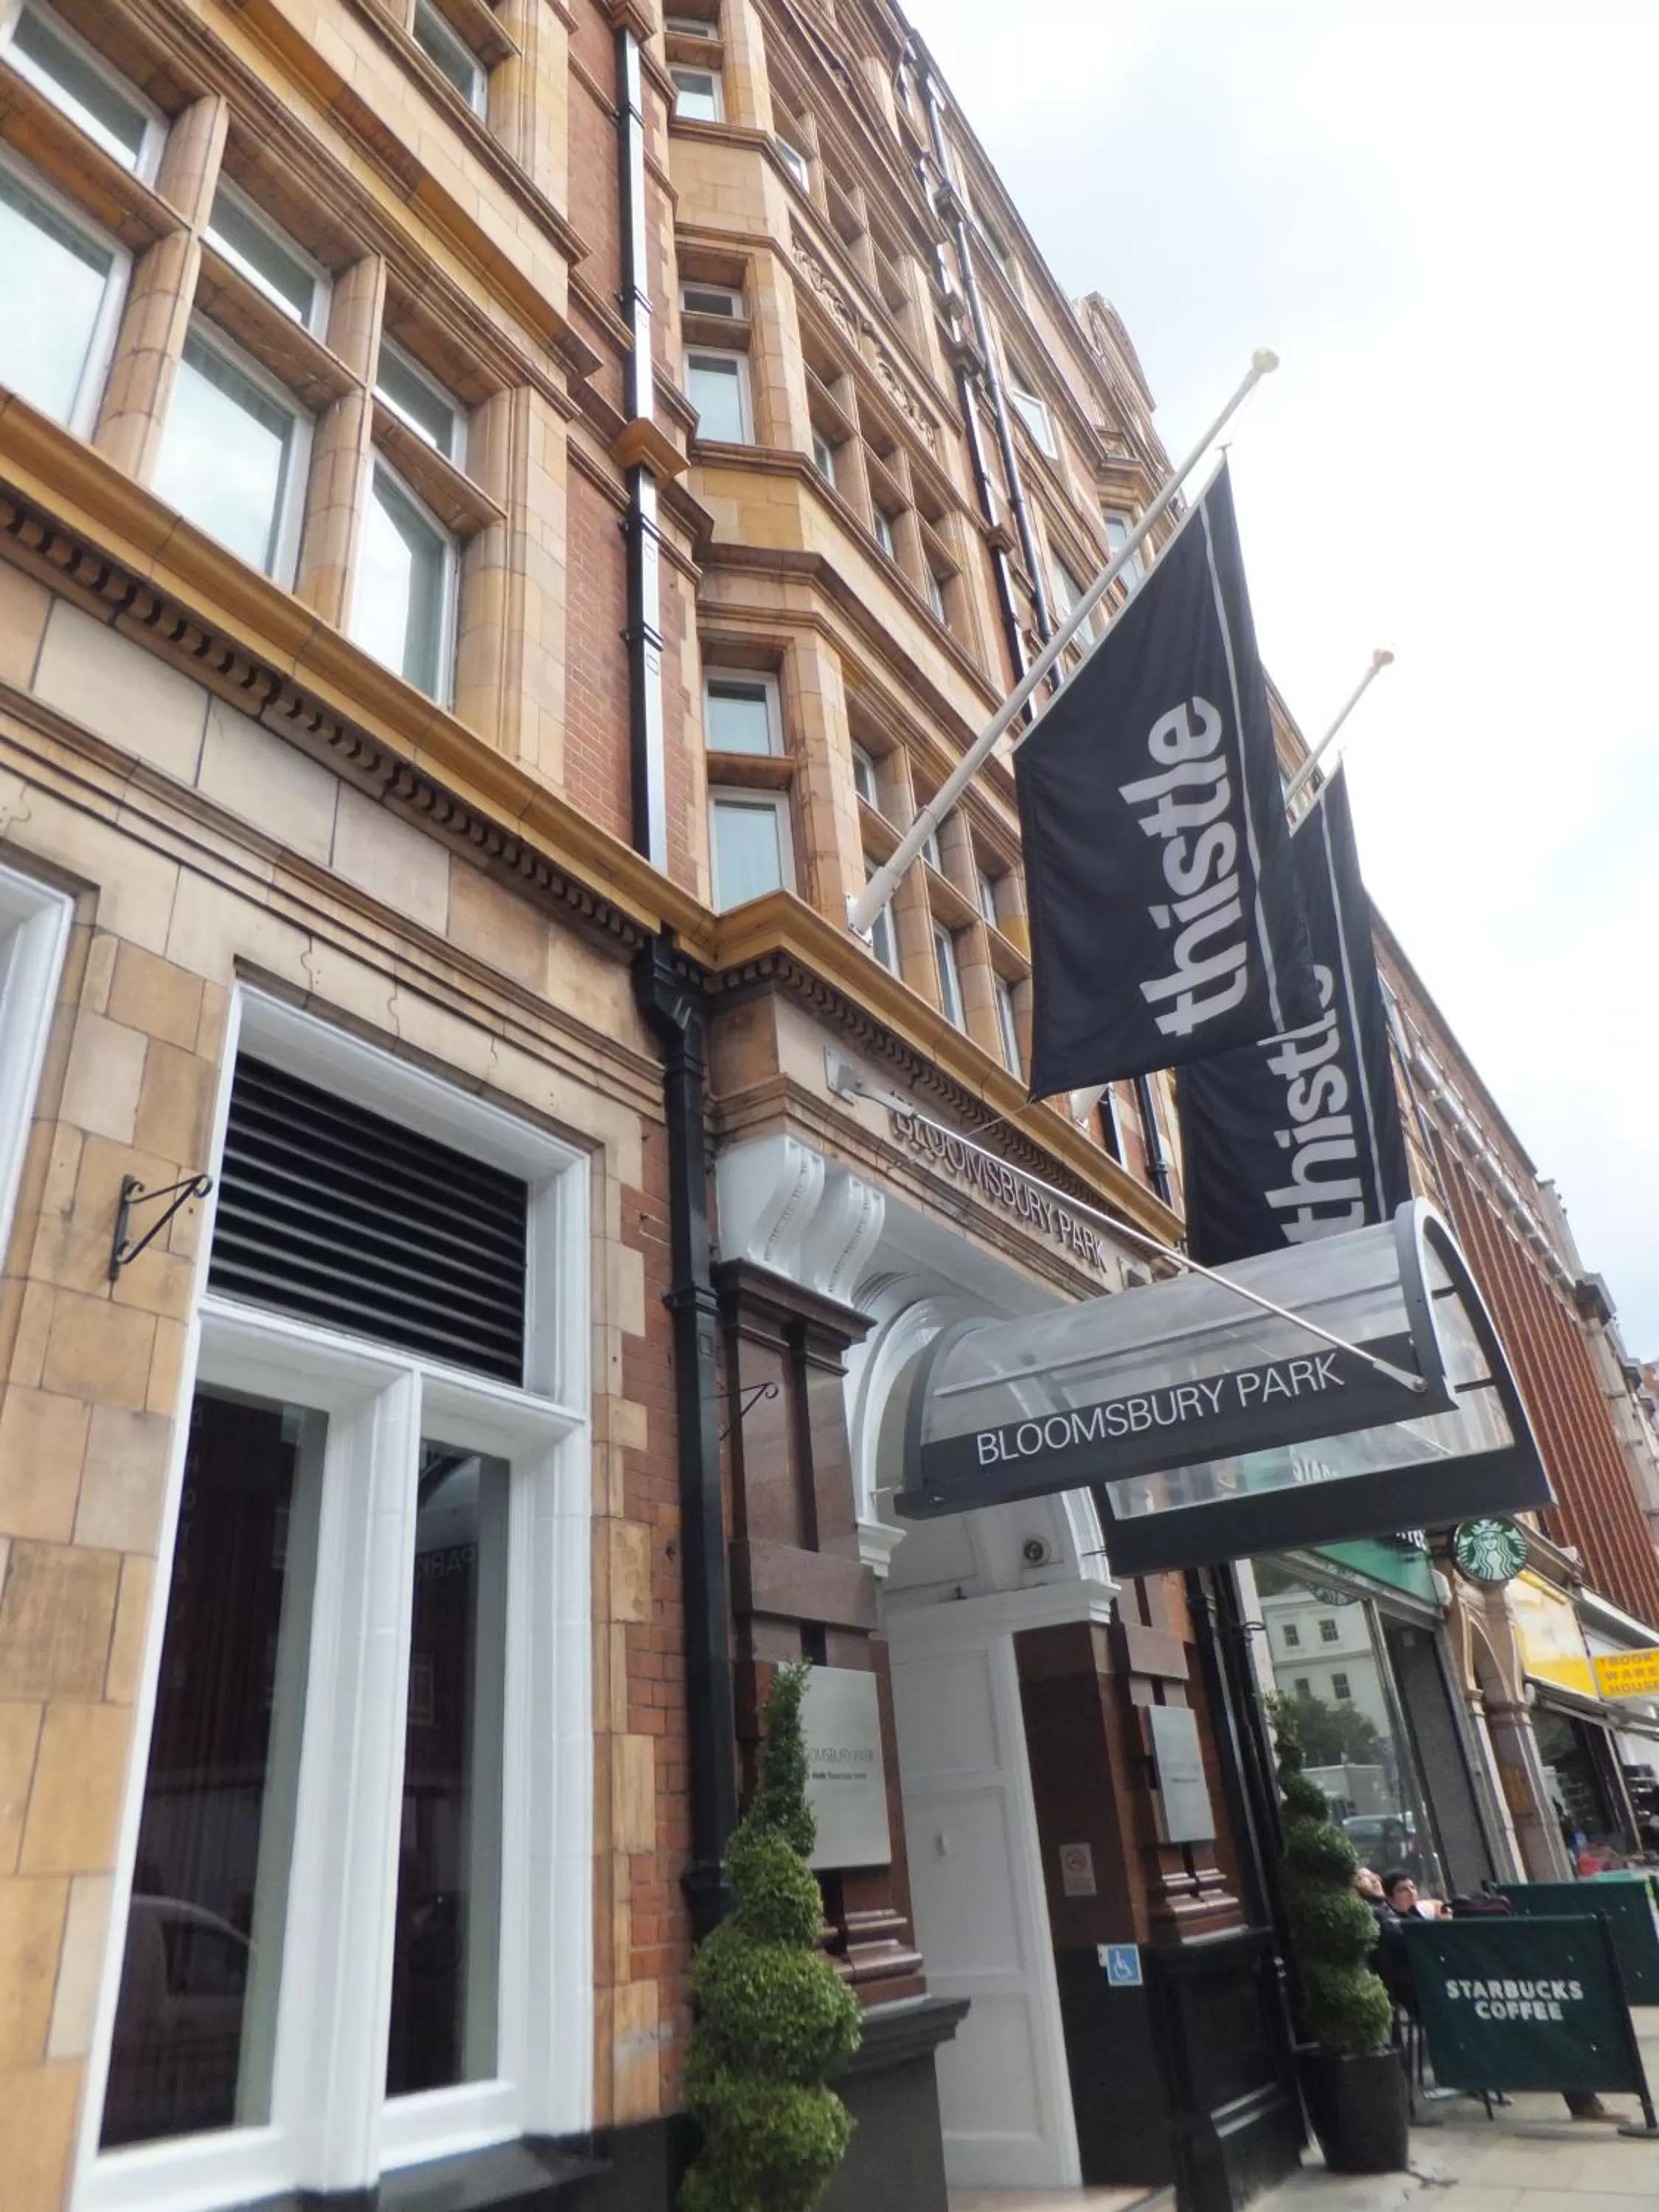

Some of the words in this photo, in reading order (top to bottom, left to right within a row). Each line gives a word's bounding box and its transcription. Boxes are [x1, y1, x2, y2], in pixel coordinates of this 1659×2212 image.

[1119, 695, 1248, 1037] thistle
[1057, 1208, 1107, 1273] PARK
[976, 1379, 1225, 1466] BLOOMSBURY
[1236, 1353, 1345, 1408] PARK
[1445, 1979, 1585, 2000] STARBUCKS
[1475, 2000, 1564, 2020] COFFEE
